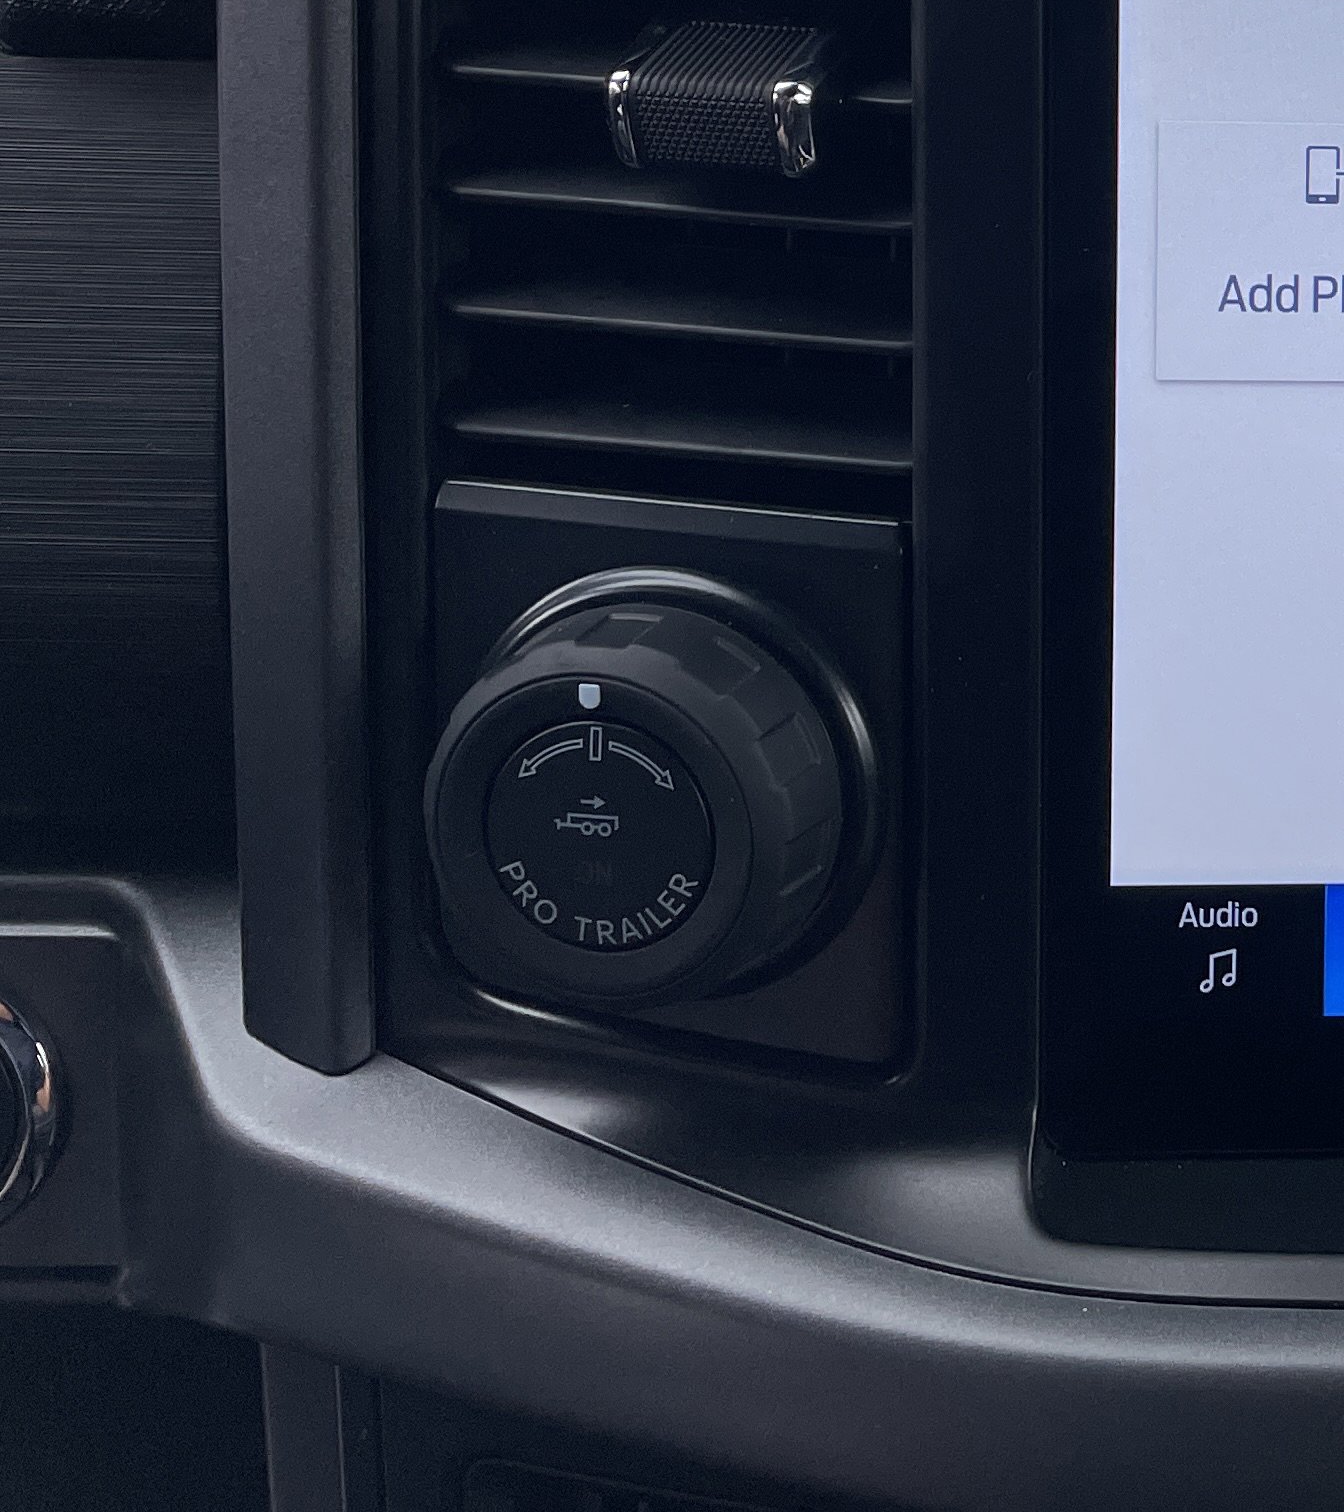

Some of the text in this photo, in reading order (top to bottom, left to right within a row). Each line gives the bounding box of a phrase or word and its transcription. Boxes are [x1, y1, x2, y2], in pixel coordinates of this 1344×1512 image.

[1218, 273, 1300, 313] Add
[499, 860, 699, 945] PRO TRAILER
[1178, 900, 1258, 928] Audio
